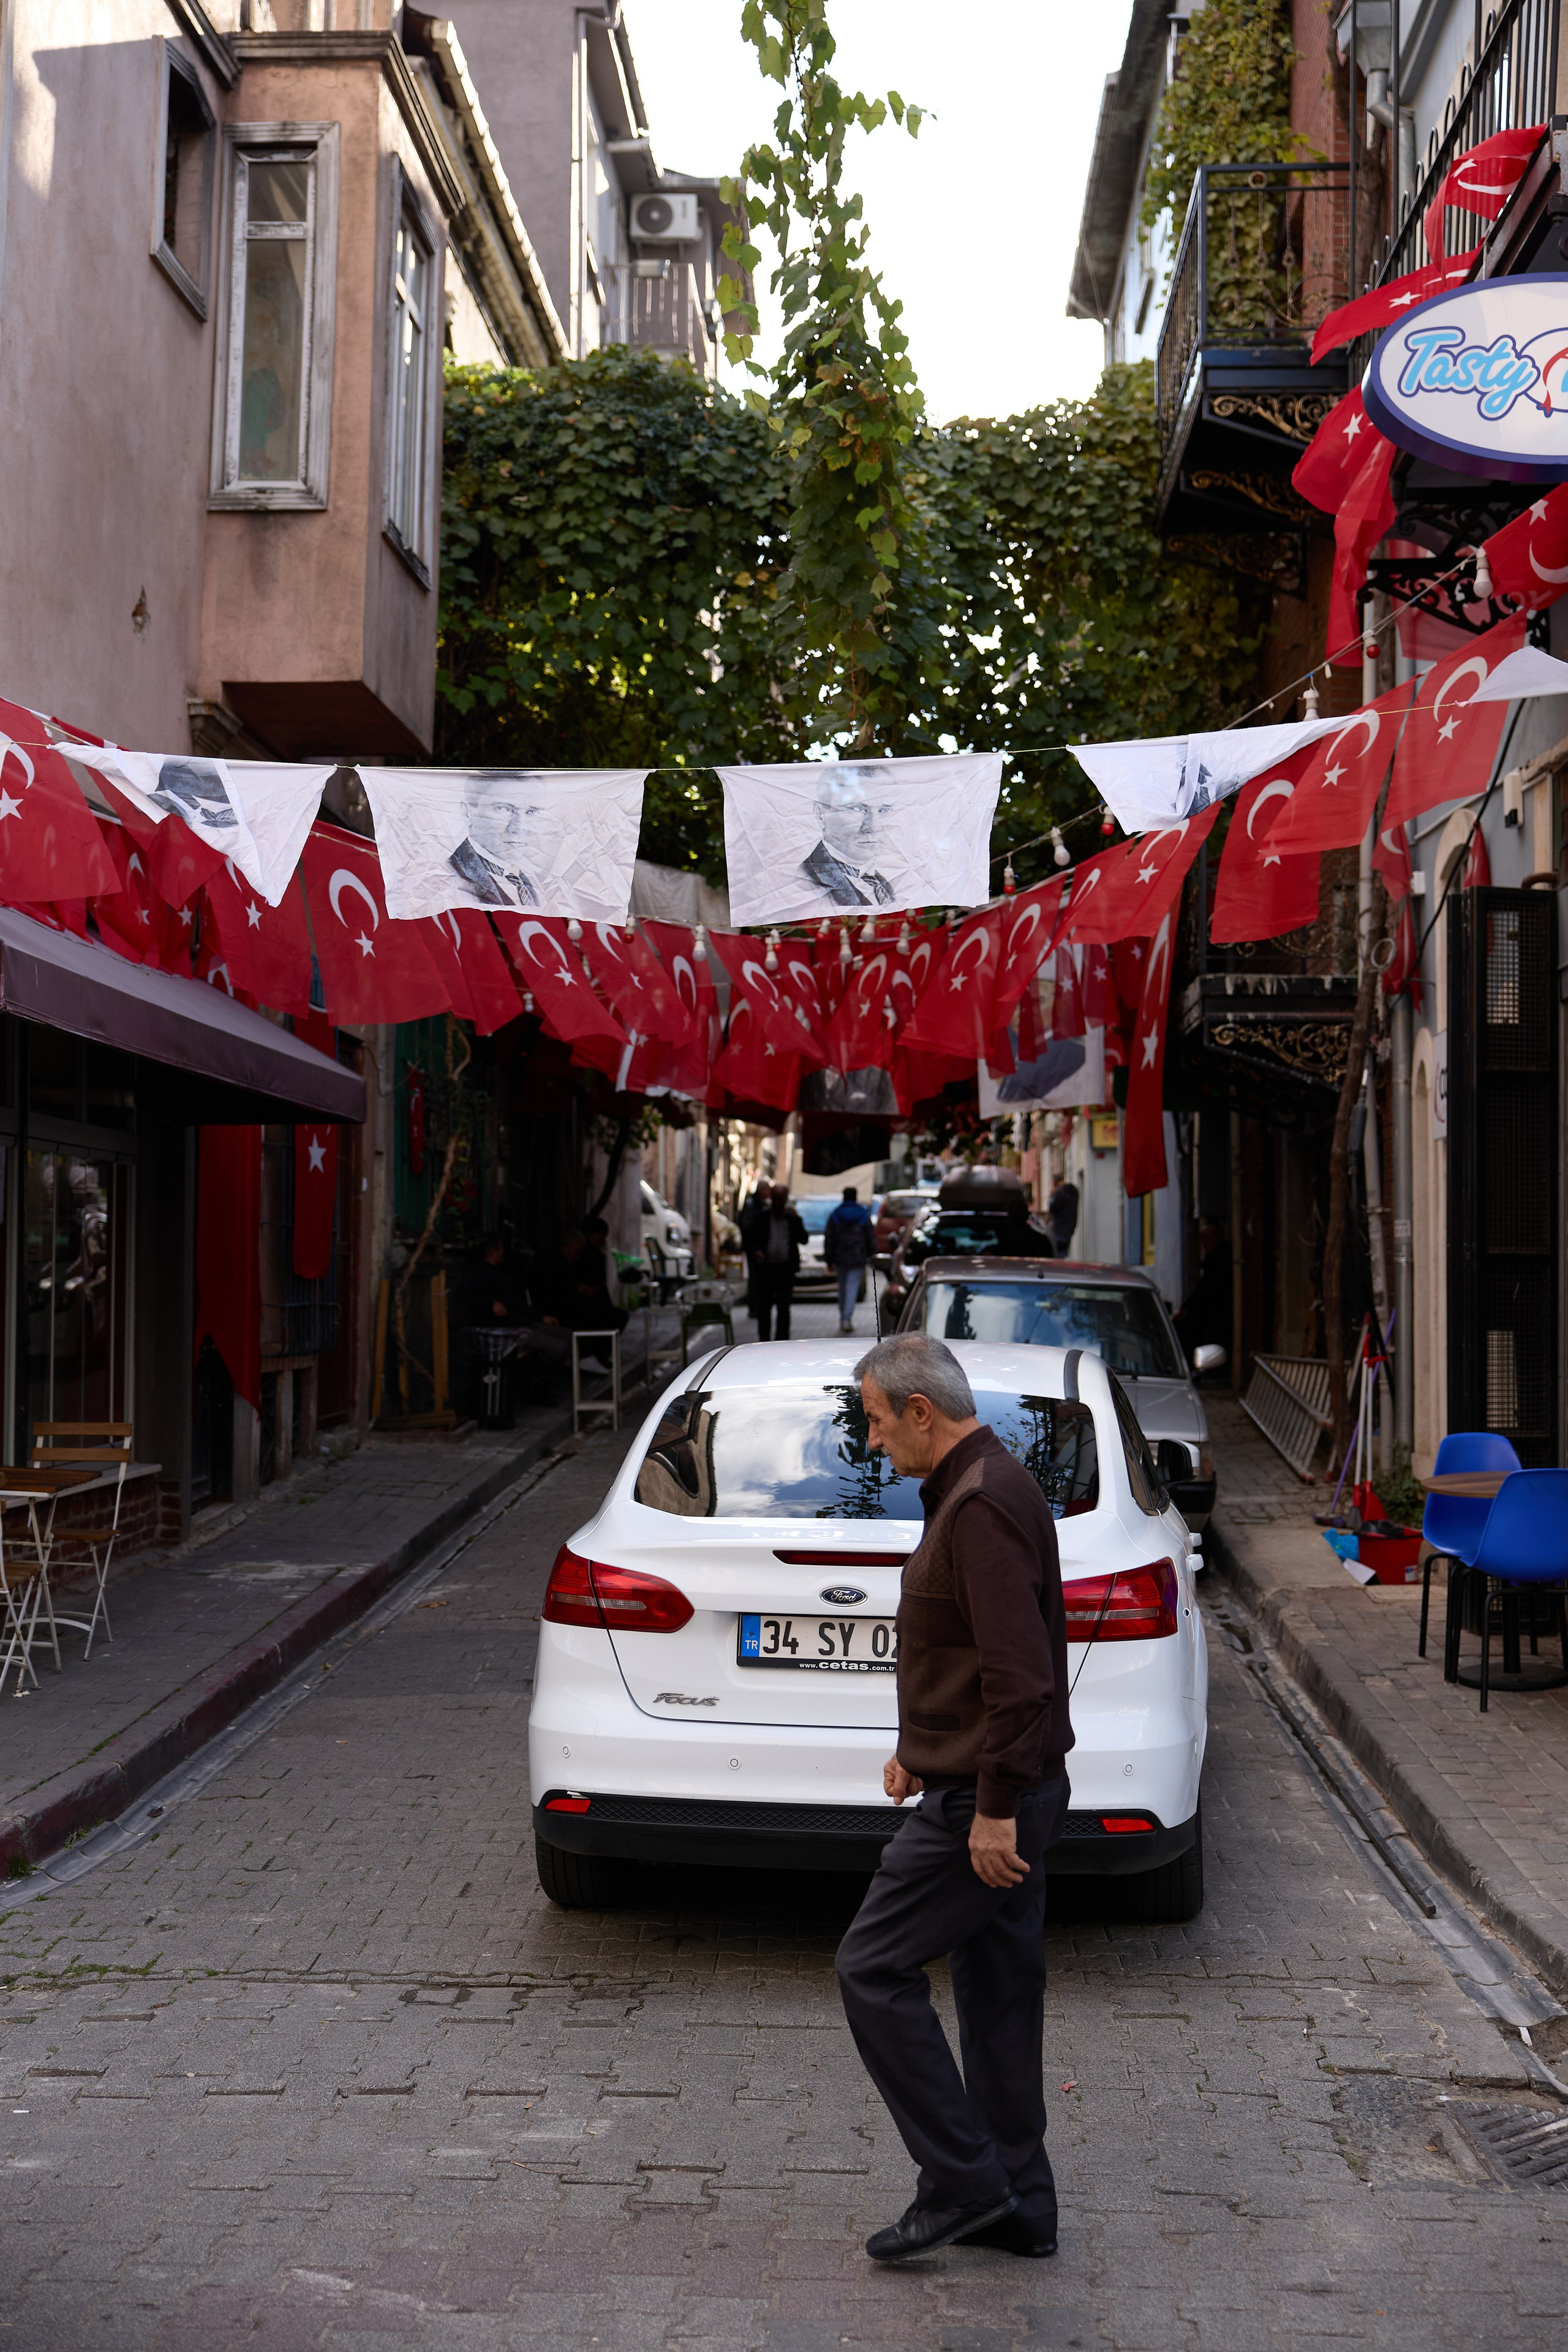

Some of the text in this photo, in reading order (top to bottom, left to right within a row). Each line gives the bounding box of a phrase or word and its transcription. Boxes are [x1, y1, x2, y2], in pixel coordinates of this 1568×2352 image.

[1403, 331, 1536, 416] Tasty
[830, 1589, 858, 1602] Ford
[745, 1640, 758, 1650] TR
[763, 1620, 799, 1654] 34
[818, 1622, 856, 1657] SY
[799, 1660, 895, 1672] www.cetas.com.tr
